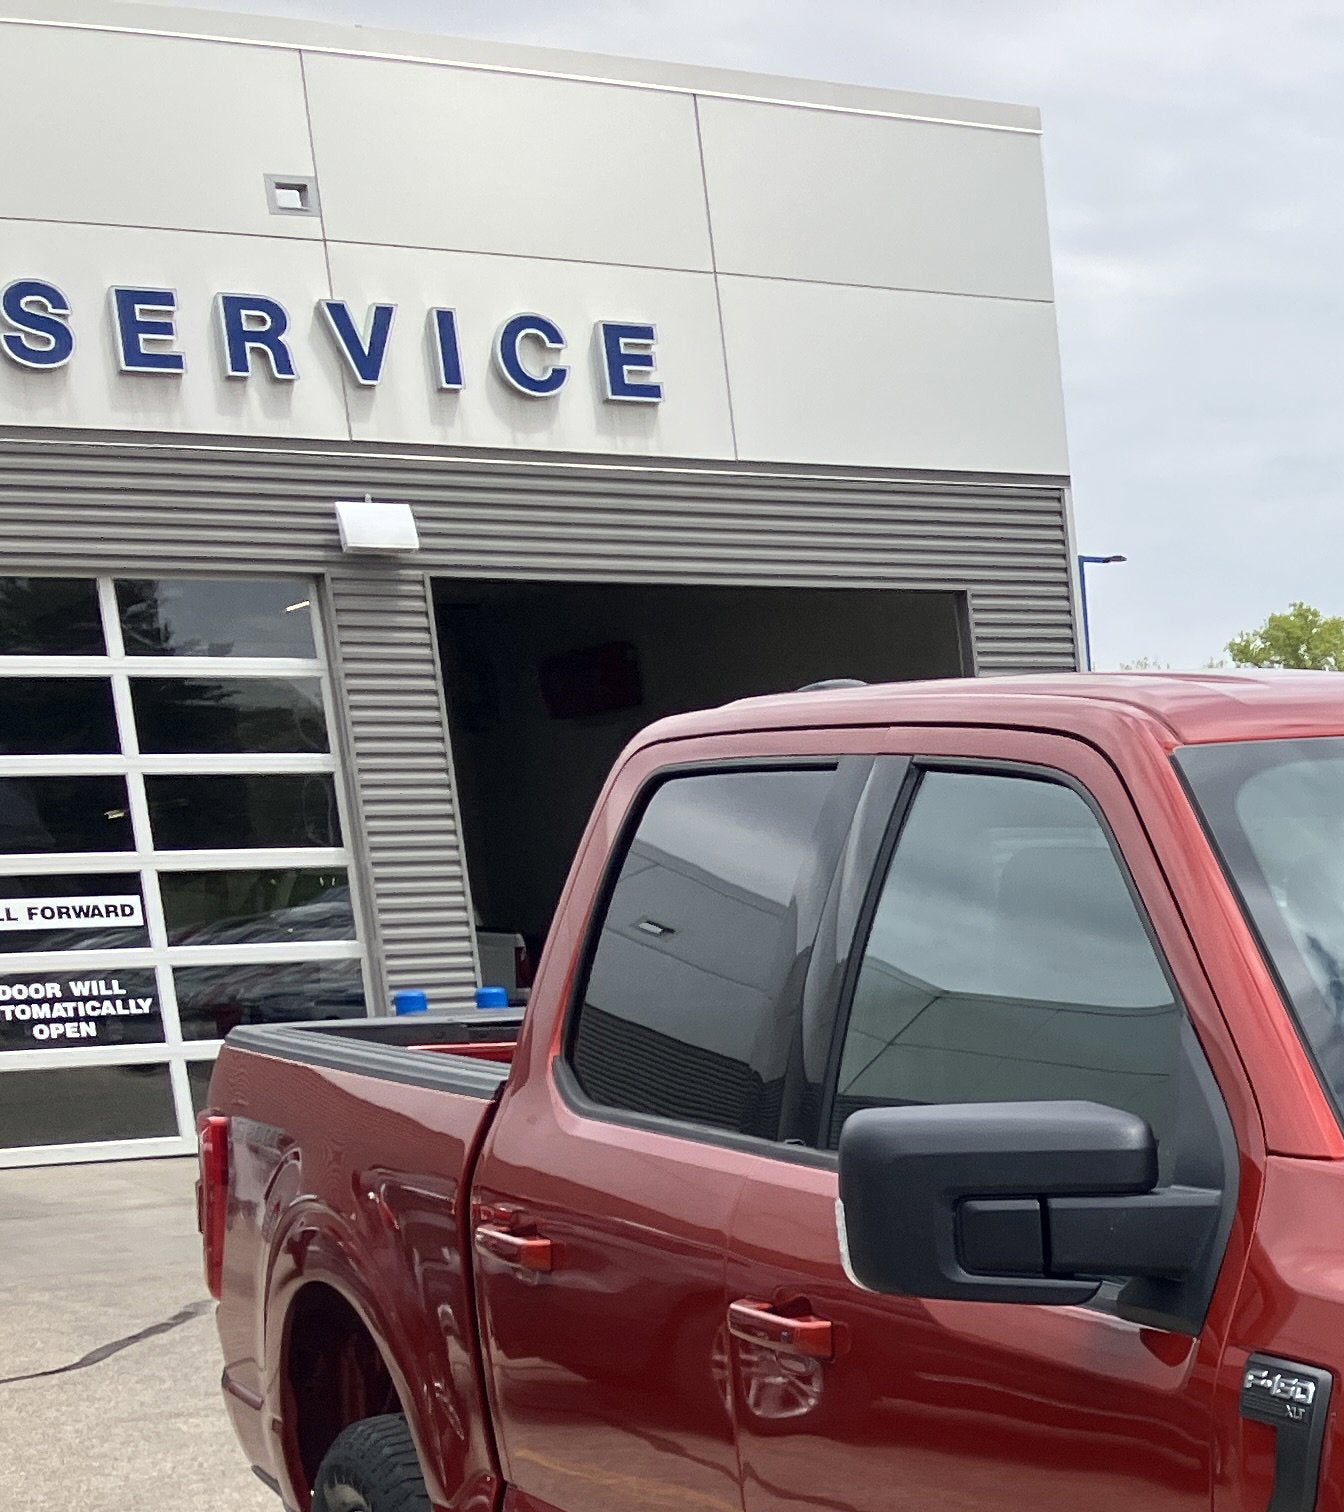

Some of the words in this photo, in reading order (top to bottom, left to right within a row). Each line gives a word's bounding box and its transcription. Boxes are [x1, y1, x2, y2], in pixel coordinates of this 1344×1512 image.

[0, 278, 664, 404] SERVICE
[26, 904, 135, 920] FORWARD
[0, 982, 62, 1001] DOOR
[69, 979, 127, 997] WILL
[32, 1021, 97, 1040] OPEN
[1243, 1369, 1315, 1404] F-150
